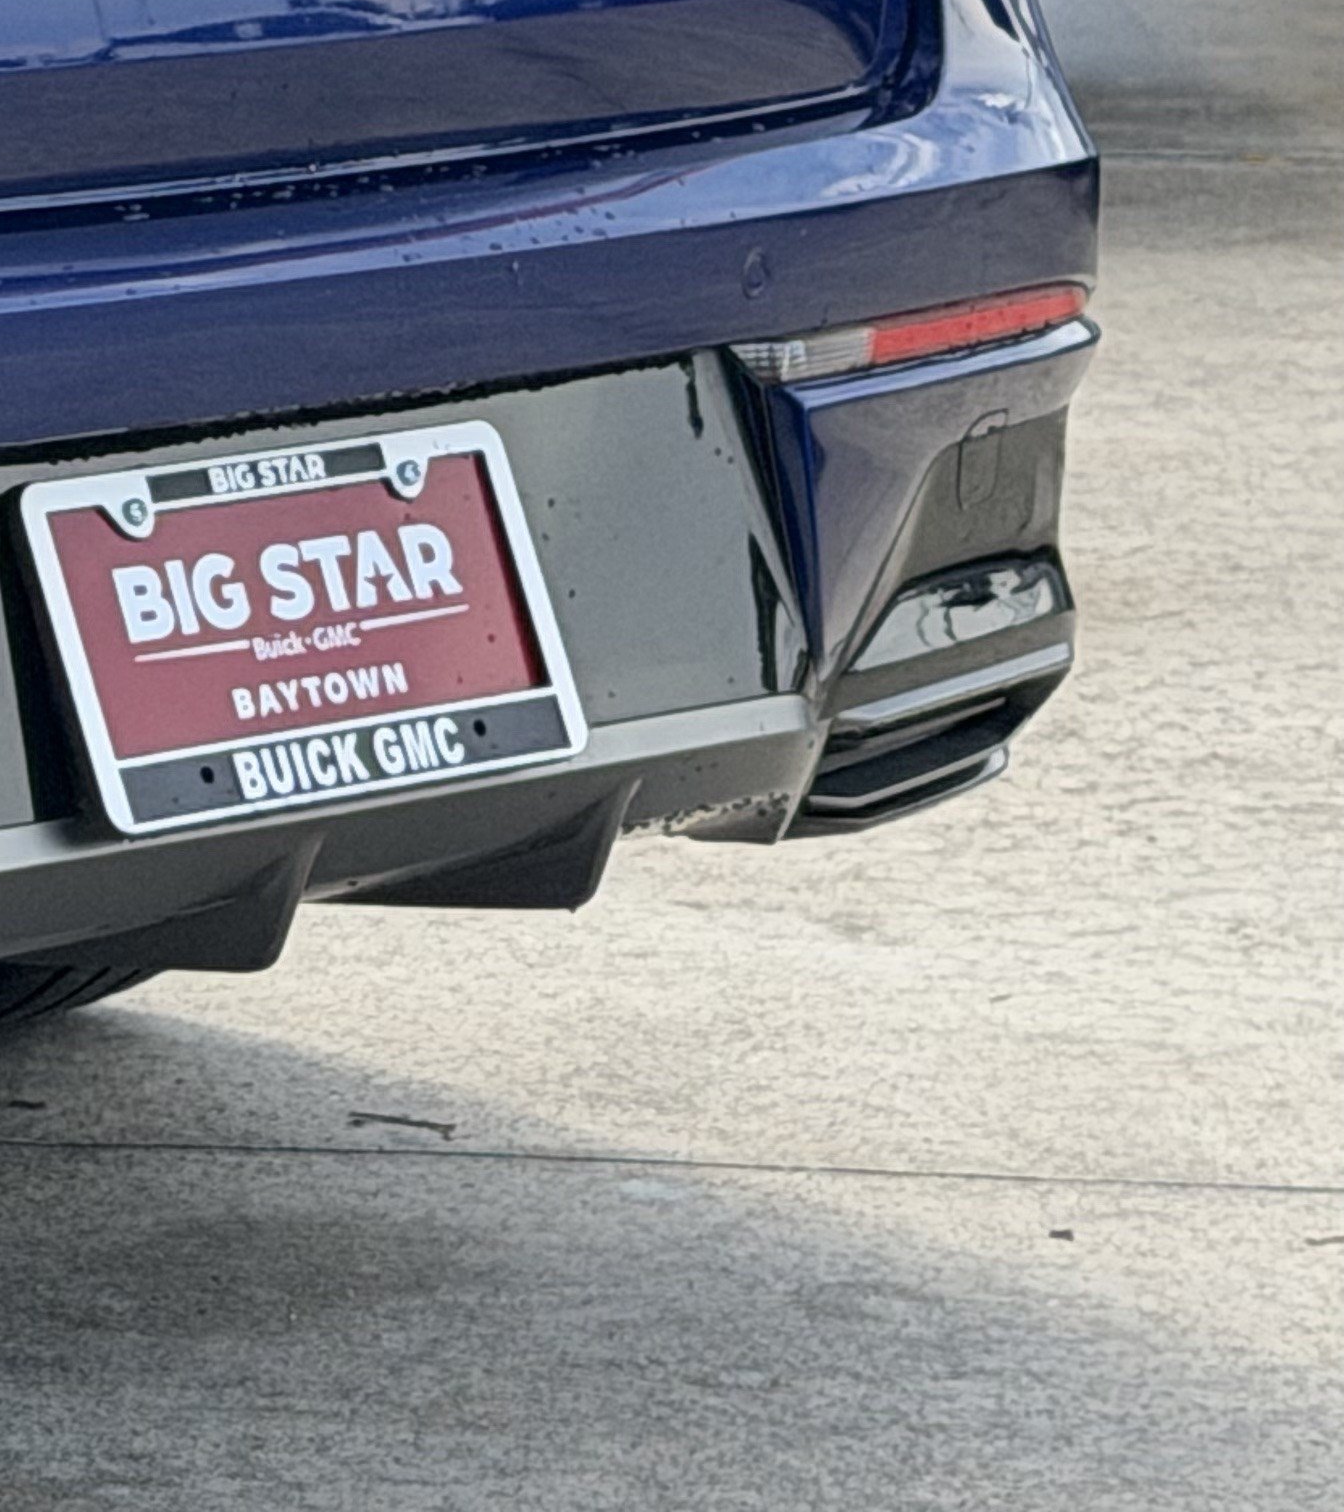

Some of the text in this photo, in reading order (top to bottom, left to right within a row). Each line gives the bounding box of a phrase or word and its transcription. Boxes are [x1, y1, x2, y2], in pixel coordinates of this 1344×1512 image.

[208, 453, 327, 495] BIG STAR
[112, 523, 463, 644] BIG STAR
[231, 662, 408, 720] BAYTOWN
[232, 717, 465, 800] BUICK GMC
